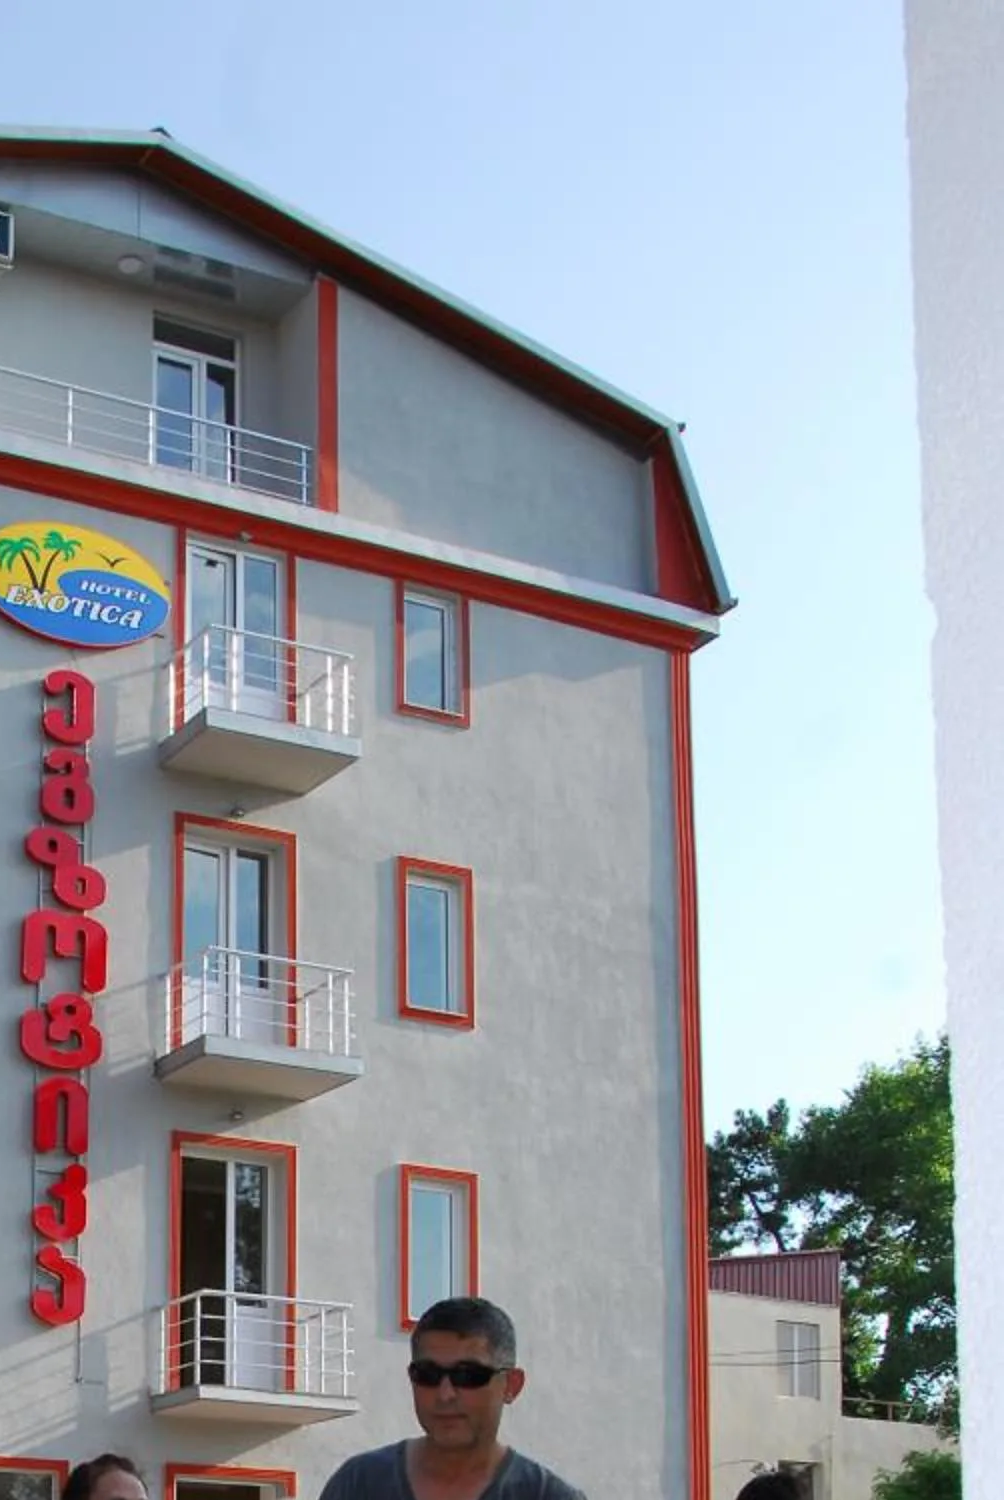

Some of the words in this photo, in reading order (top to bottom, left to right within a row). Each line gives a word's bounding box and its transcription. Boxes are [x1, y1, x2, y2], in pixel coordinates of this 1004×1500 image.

[5, 583, 144, 629] EXOTICA
[79, 578, 150, 605] HOTEL
[21, 669, 108, 1326] ეგზოტიკა
